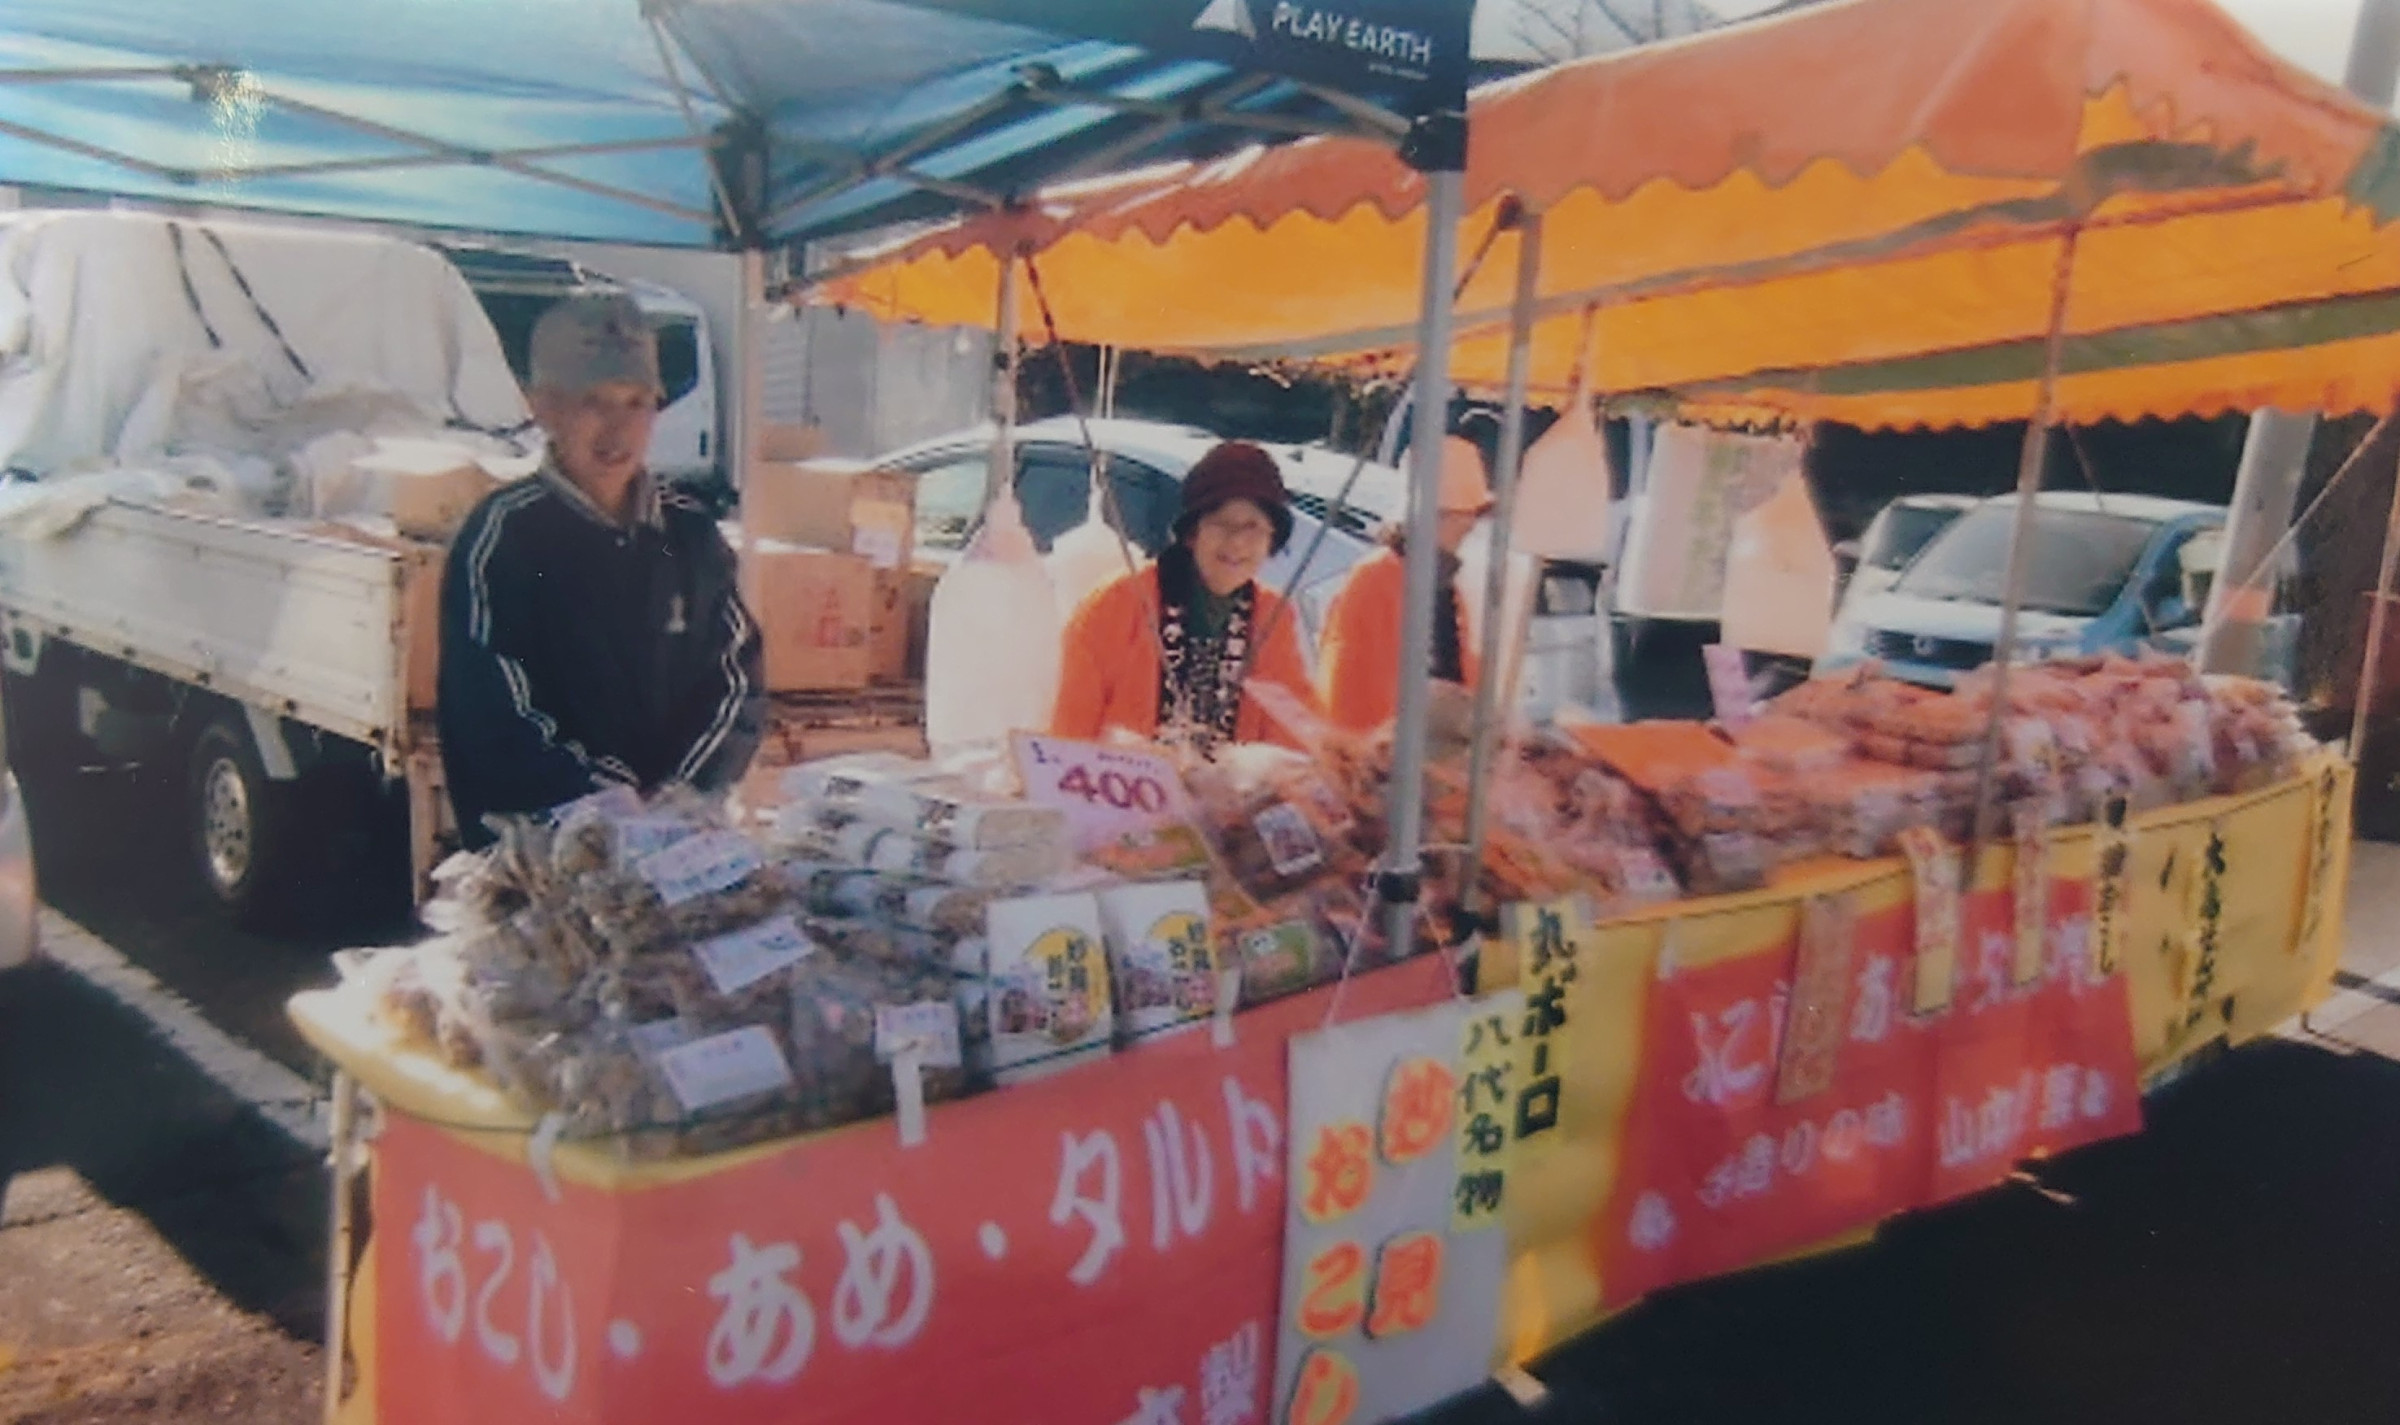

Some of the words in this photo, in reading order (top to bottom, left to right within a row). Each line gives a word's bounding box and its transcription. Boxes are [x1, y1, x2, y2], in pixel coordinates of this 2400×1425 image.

[1272, 1, 1343, 42] PLAY
[1345, 17, 1432, 65] EARTH
[1058, 765, 1166, 814] 400
[1454, 1014, 1512, 1216] 八代名物
